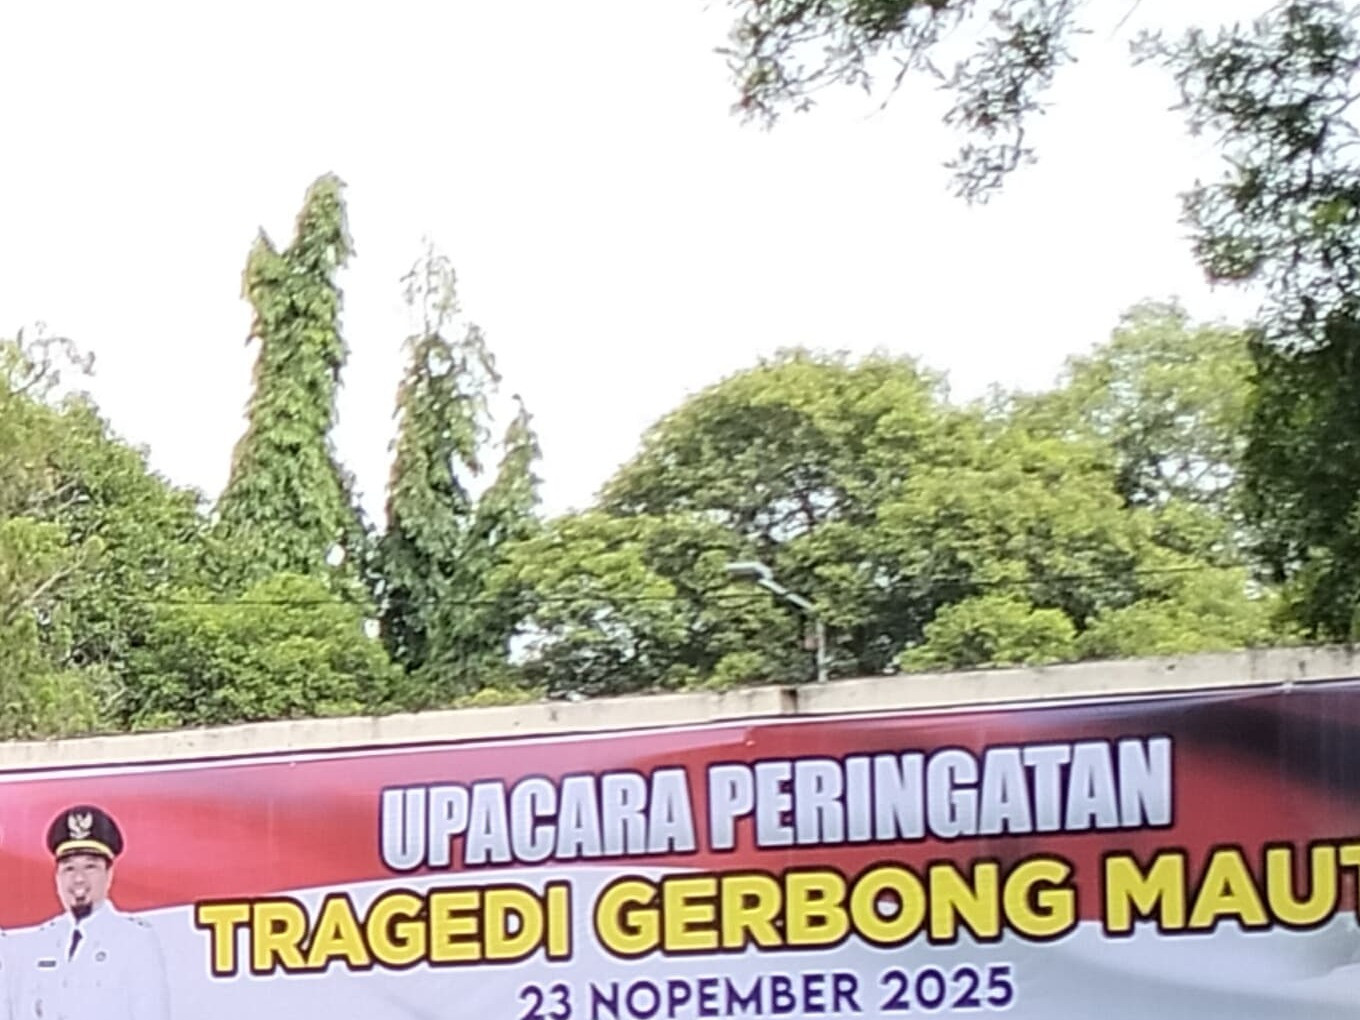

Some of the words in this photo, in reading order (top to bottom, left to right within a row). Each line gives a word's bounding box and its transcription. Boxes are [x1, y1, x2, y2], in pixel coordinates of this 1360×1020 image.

[381, 768, 695, 869] UPACARA
[708, 737, 1173, 851] PERINGATAN
[196, 884, 570, 973] TRAGEDI
[594, 858, 1076, 955] GERBONG
[879, 966, 1015, 1012] 2025
